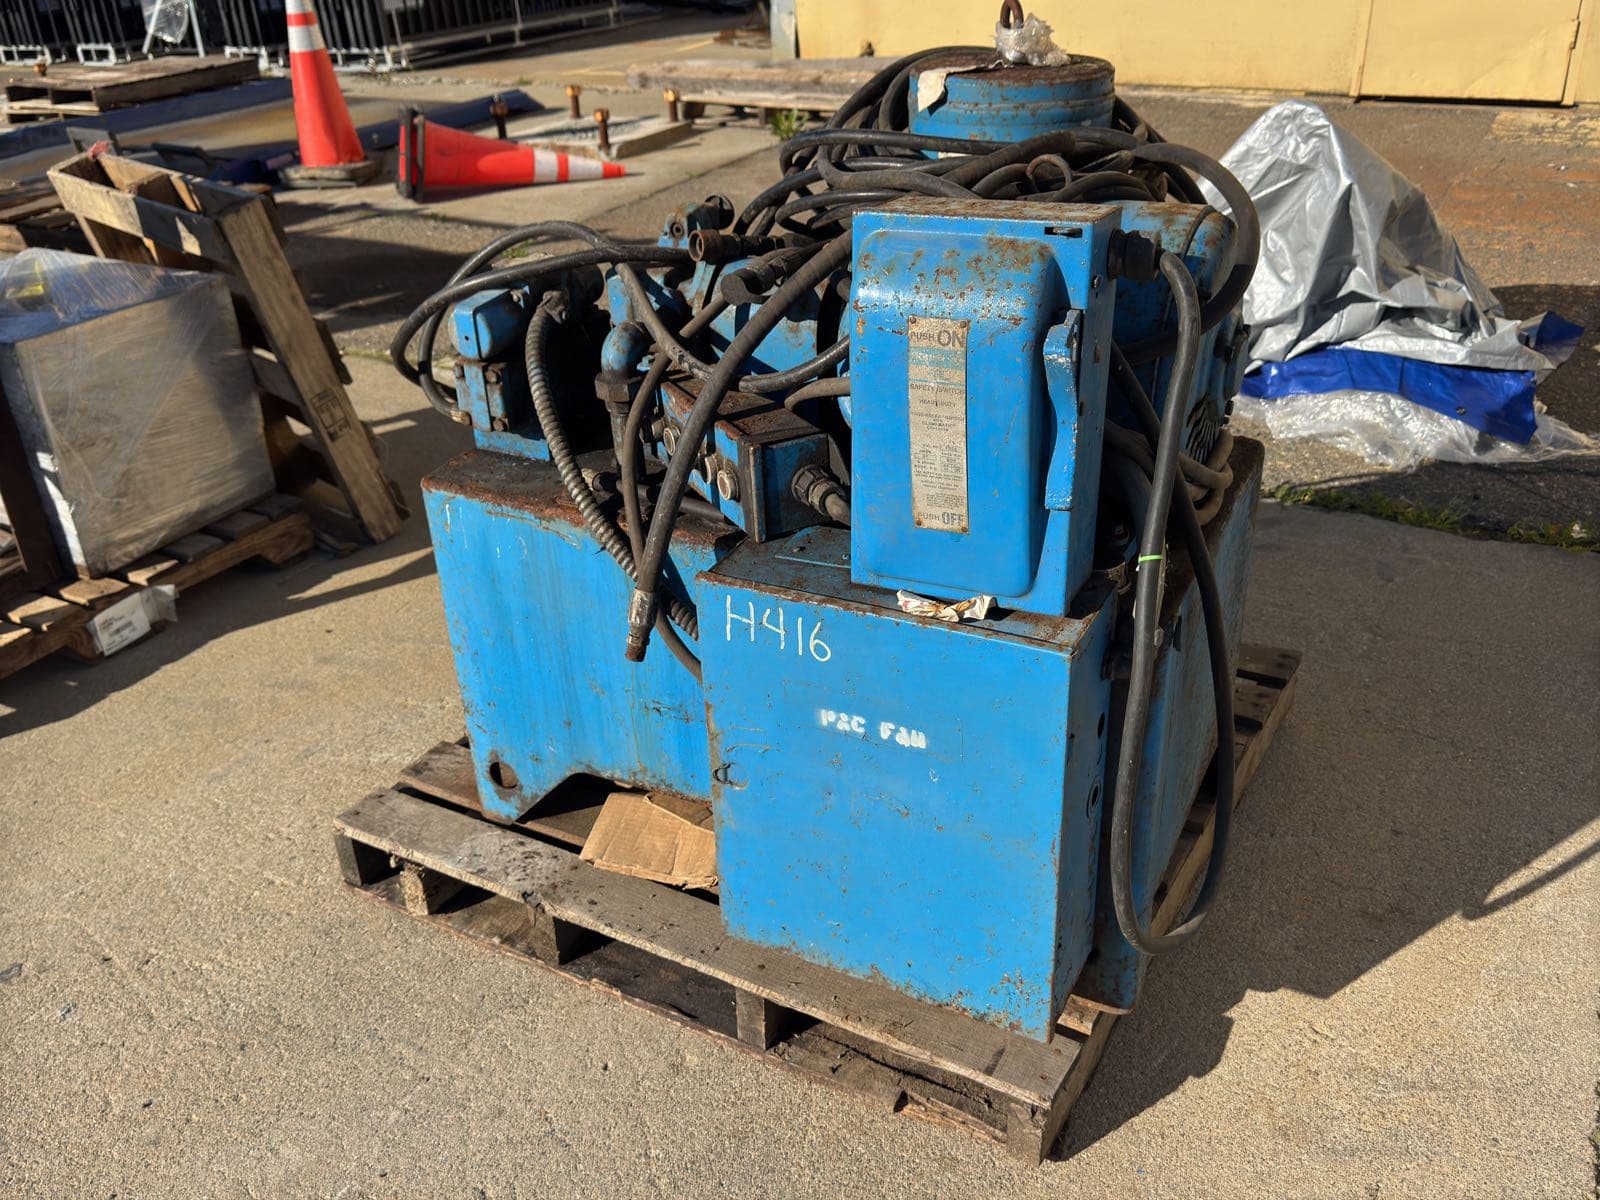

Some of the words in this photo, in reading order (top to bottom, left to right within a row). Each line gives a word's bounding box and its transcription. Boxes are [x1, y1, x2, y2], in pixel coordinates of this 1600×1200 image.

[910, 331, 935, 341] PUSH
[938, 329, 966, 348] ON
[917, 512, 940, 521] PUSH
[941, 511, 965, 527] OFF
[725, 594, 833, 662] H416
